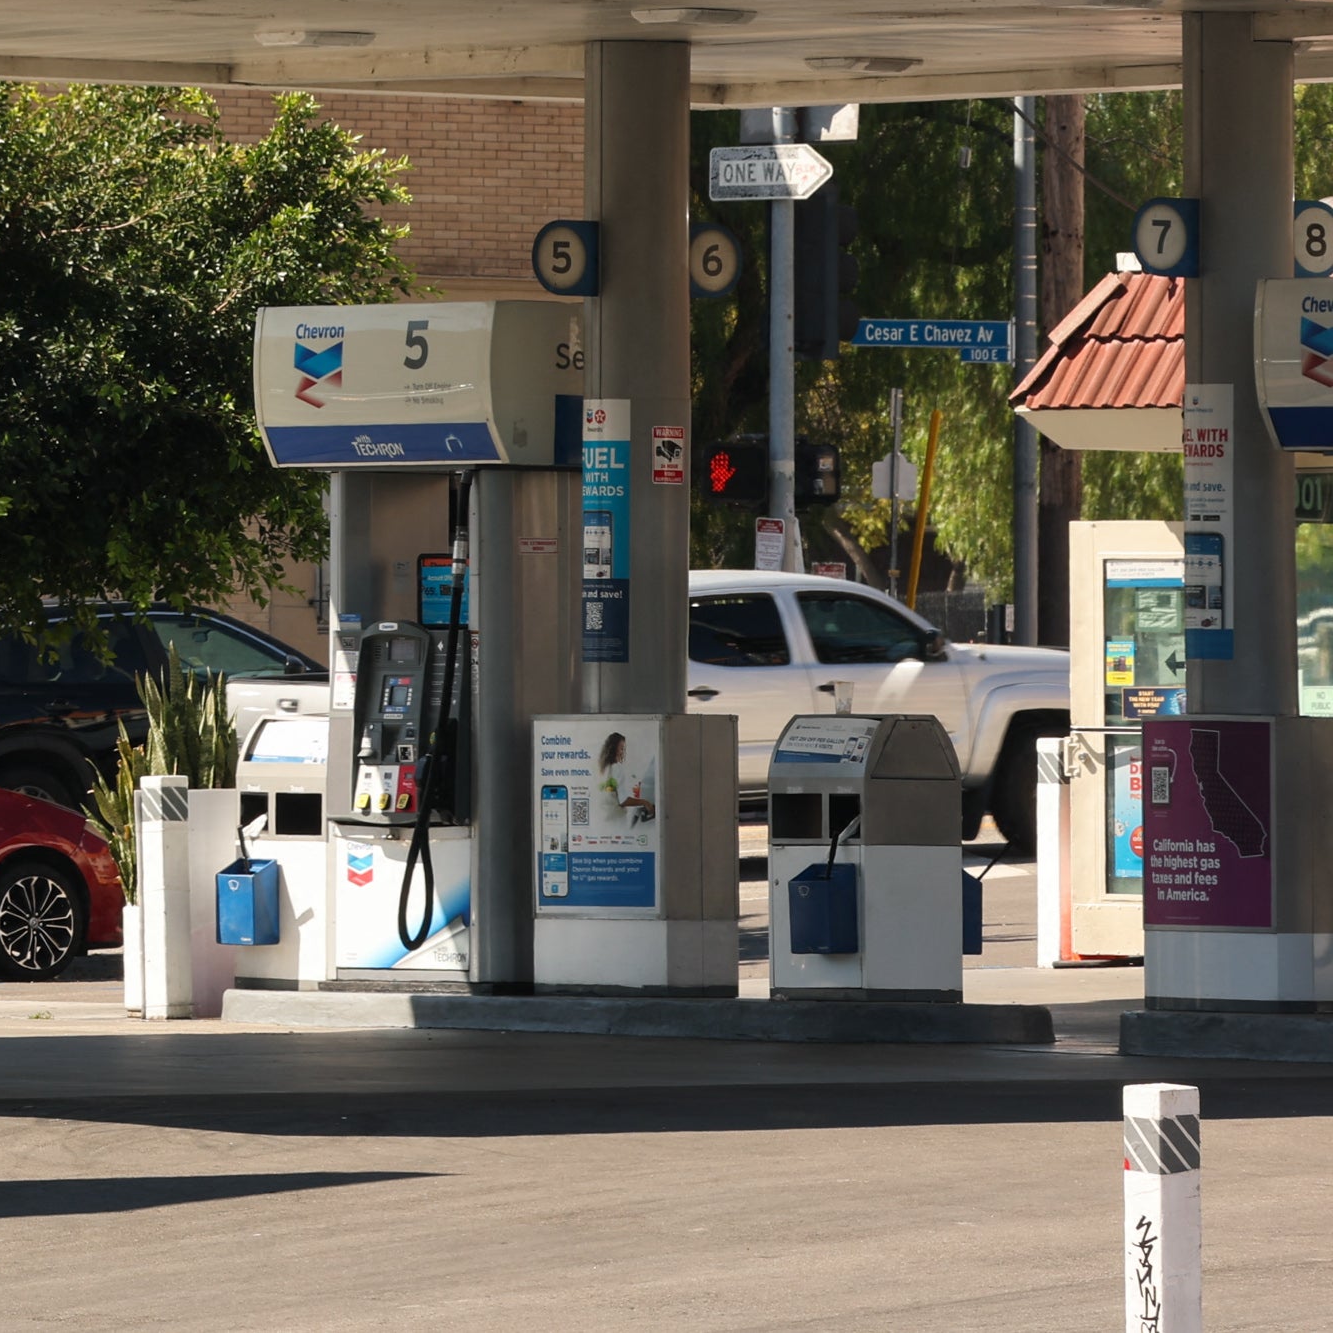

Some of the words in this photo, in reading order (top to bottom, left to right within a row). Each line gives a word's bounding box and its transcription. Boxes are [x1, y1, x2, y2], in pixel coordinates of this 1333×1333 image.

[723, 163, 757, 183] ONE
[763, 162, 797, 183] WAY
[1151, 219, 1172, 254] 7
[1305, 223, 1327, 257] 8
[552, 241, 572, 275] 5
[702, 244, 723, 277] 6
[295, 323, 345, 340] Chevron
[865, 324, 904, 342] Cesar
[910, 325, 919, 342] E
[924, 325, 972, 343] Chavez
[976, 326, 994, 342] Av
[403, 319, 429, 370] 5
[970, 350, 989, 361] 100
[991, 350, 998, 360] E
[355, 434, 372, 444] with
[656, 428, 683, 438] WARNING
[1197, 428, 1228, 443] WITH
[351, 441, 405, 458] TECHRON
[585, 471, 609, 483] WITH
[1203, 482, 1226, 492] save.
[599, 590, 623, 599] save!
[541, 735, 572, 746] Combine
[541, 751, 555, 761] your
[557, 749, 591, 760] rewards.
[541, 768, 554, 776] Save
[1153, 839, 1193, 853] California
[1196, 839, 1216, 853] has
[1150, 854, 1163, 867] the
[1164, 854, 1198, 871] highest
[1200, 856, 1221, 871] gas
[1152, 871, 1173, 884] taxes
[1174, 871, 1193, 885] and
[1194, 871, 1218, 885] fees
[1157, 887, 1165, 900] in
